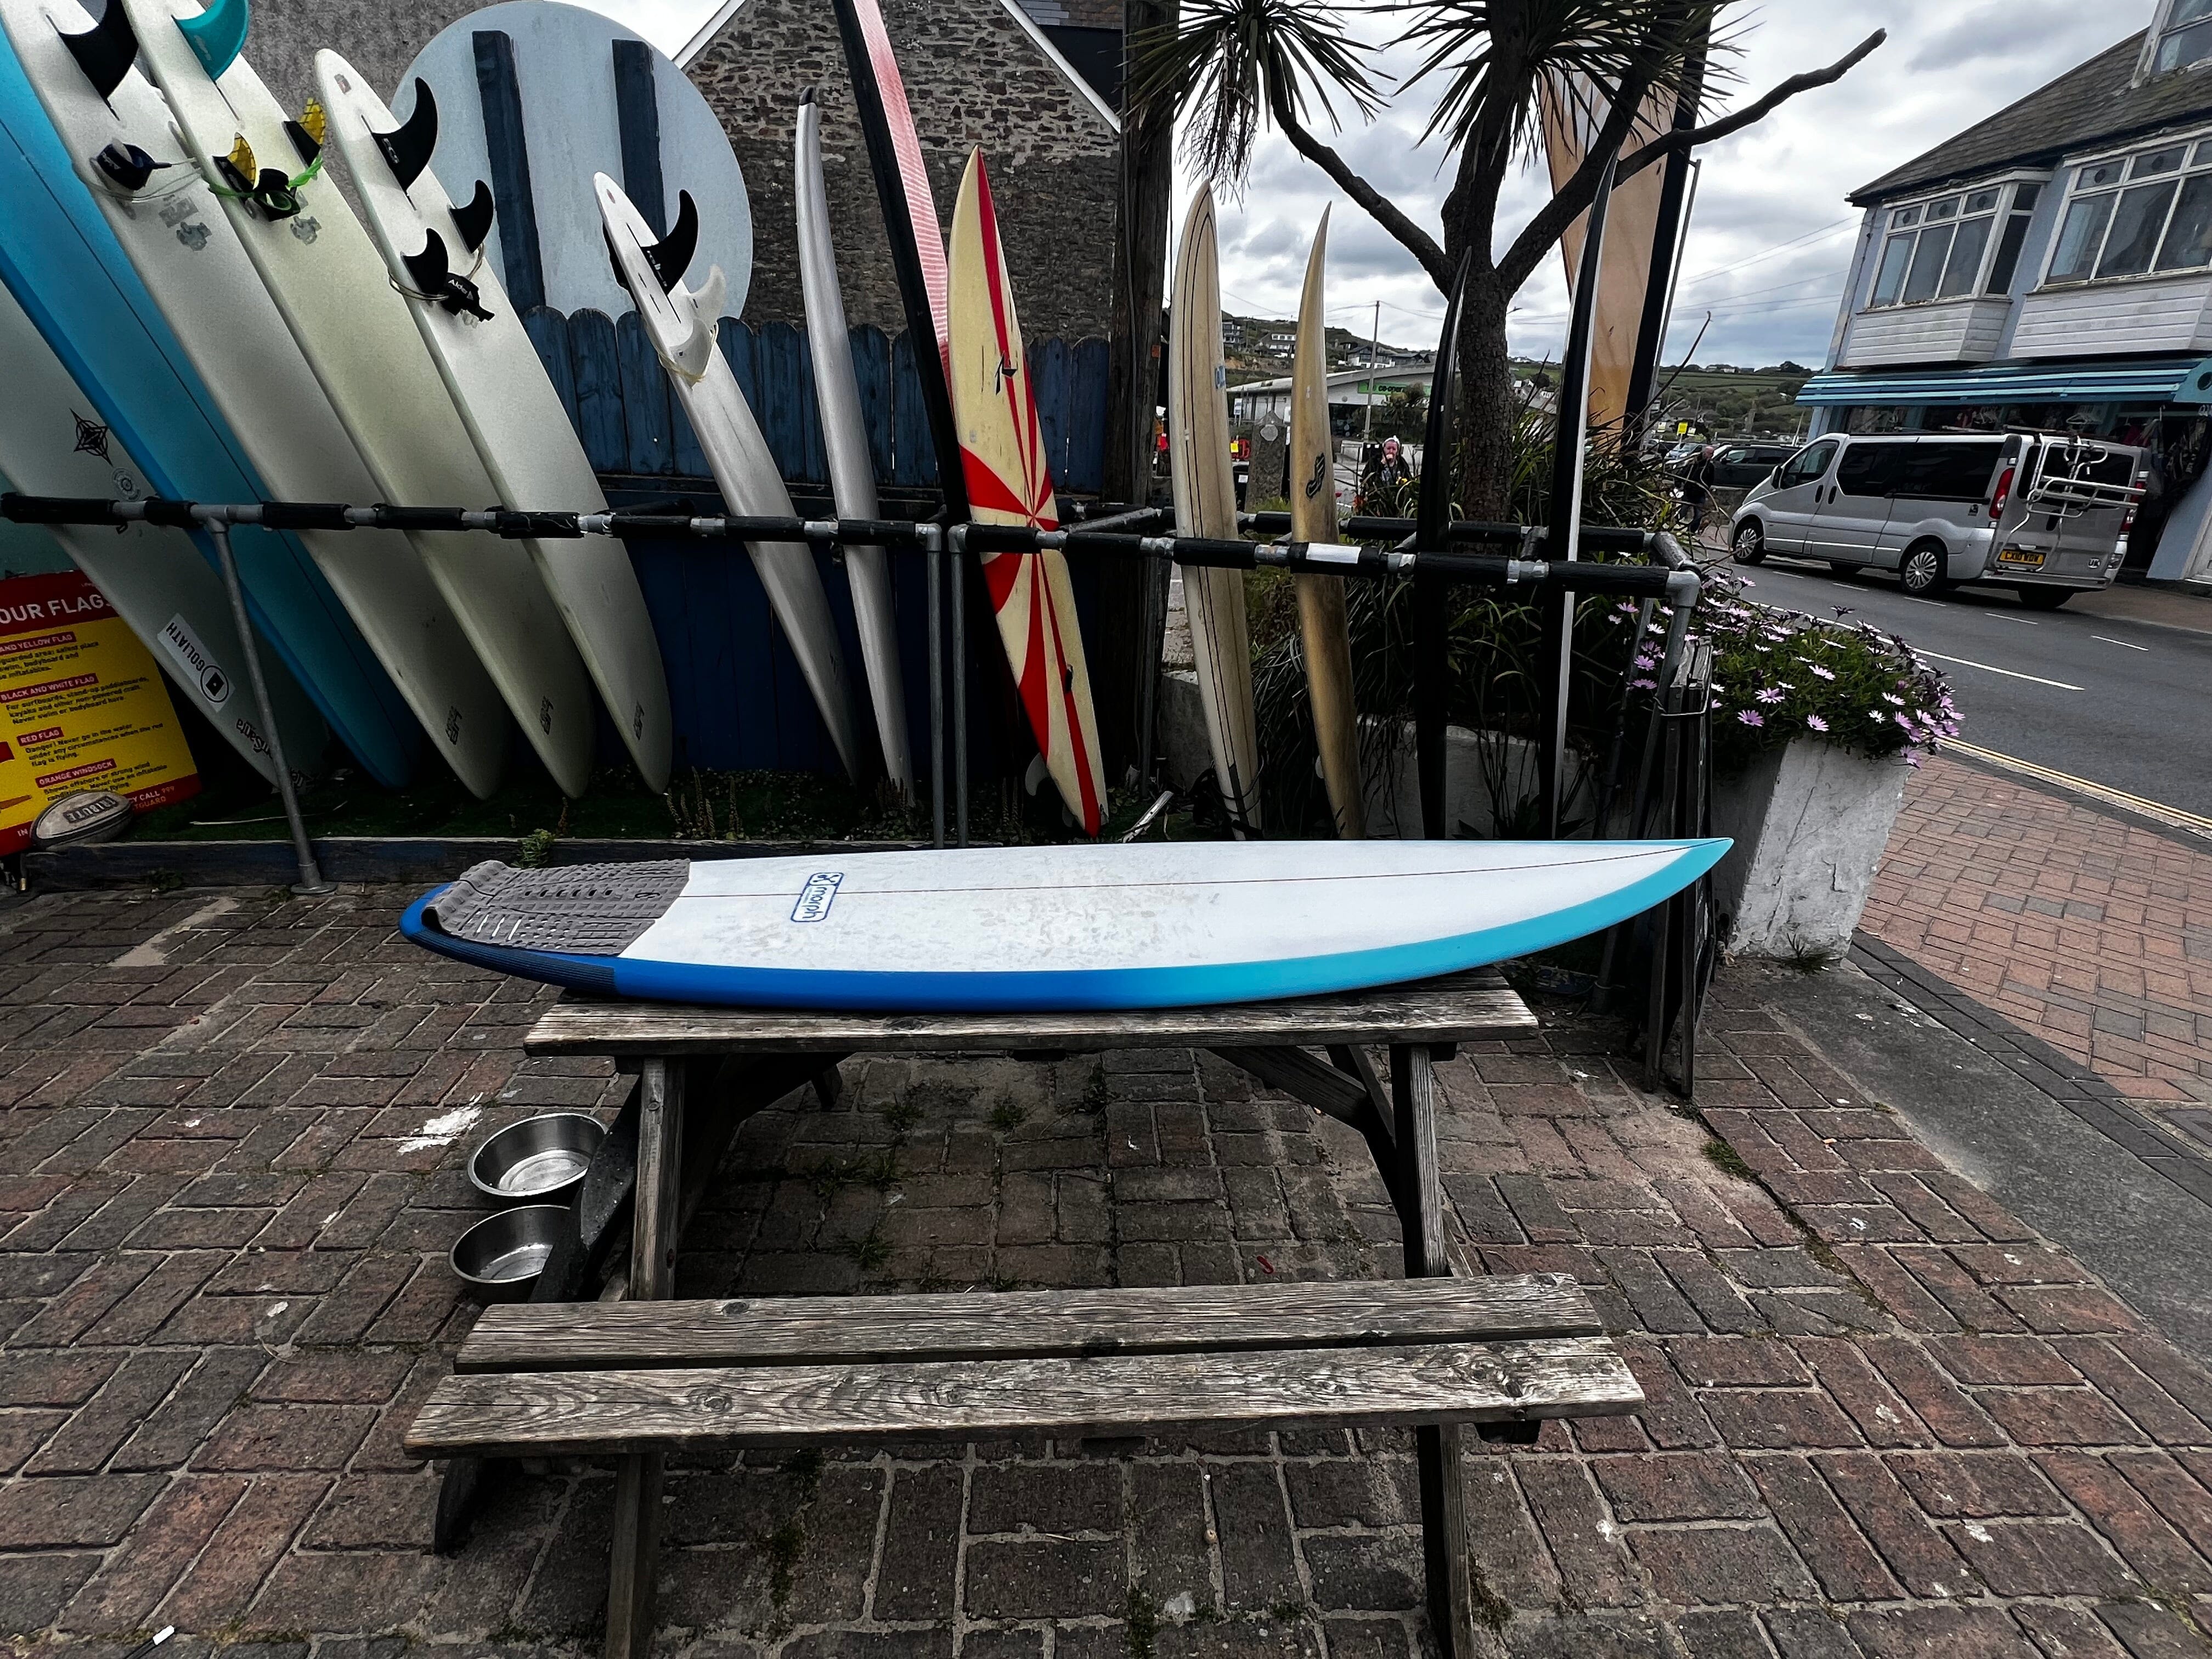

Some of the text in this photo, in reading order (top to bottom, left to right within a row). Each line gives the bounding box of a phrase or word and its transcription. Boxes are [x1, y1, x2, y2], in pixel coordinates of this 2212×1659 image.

[0, 594, 111, 624] OUR FLAG
[17, 639, 50, 648] YELLOW
[52, 634, 72, 642] FLAG
[166, 622, 205, 671] GOLIATH
[1, 676, 95, 701] BLACK AND WHITE FLAG
[20, 730, 60, 743] RED FLAG
[39, 760, 113, 785] ORANGE WINDSOCK
[133, 796, 166, 810] TGUARD
[139, 791, 160, 801] CALL
[802, 887, 827, 919] morph
